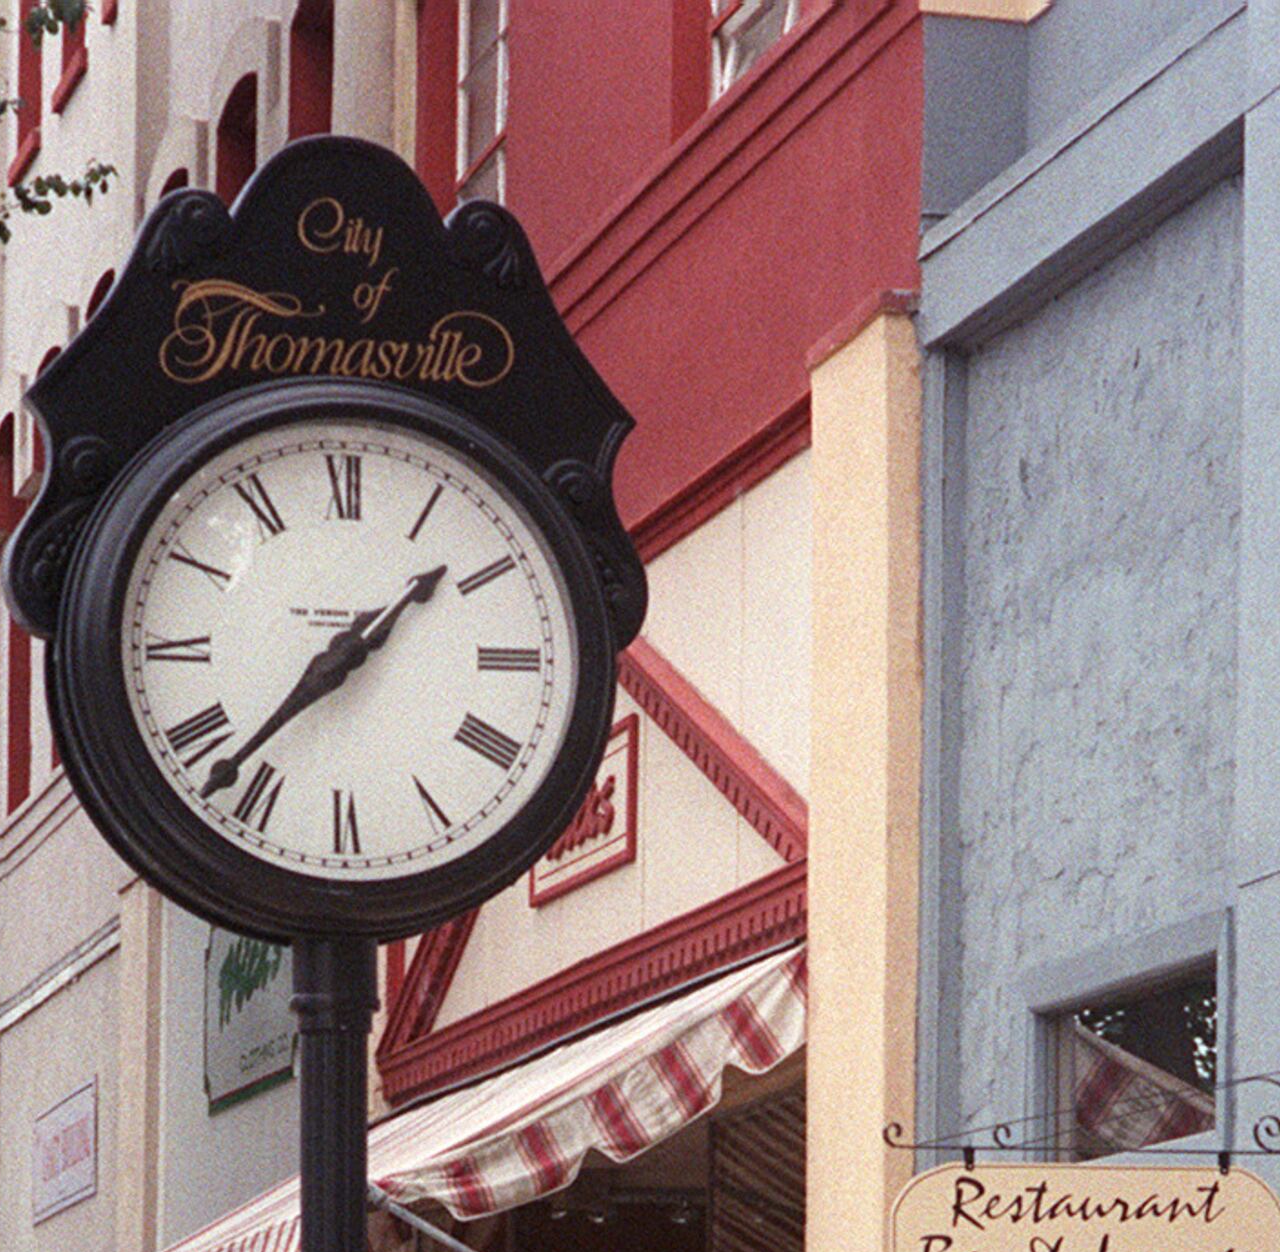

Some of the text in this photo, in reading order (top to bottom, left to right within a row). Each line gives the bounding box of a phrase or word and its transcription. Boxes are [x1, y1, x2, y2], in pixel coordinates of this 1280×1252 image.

[297, 197, 383, 267] City
[352, 267, 400, 324] of
[159, 278, 515, 388] Thomasville
[951, 1176, 1227, 1231] Restaurant
